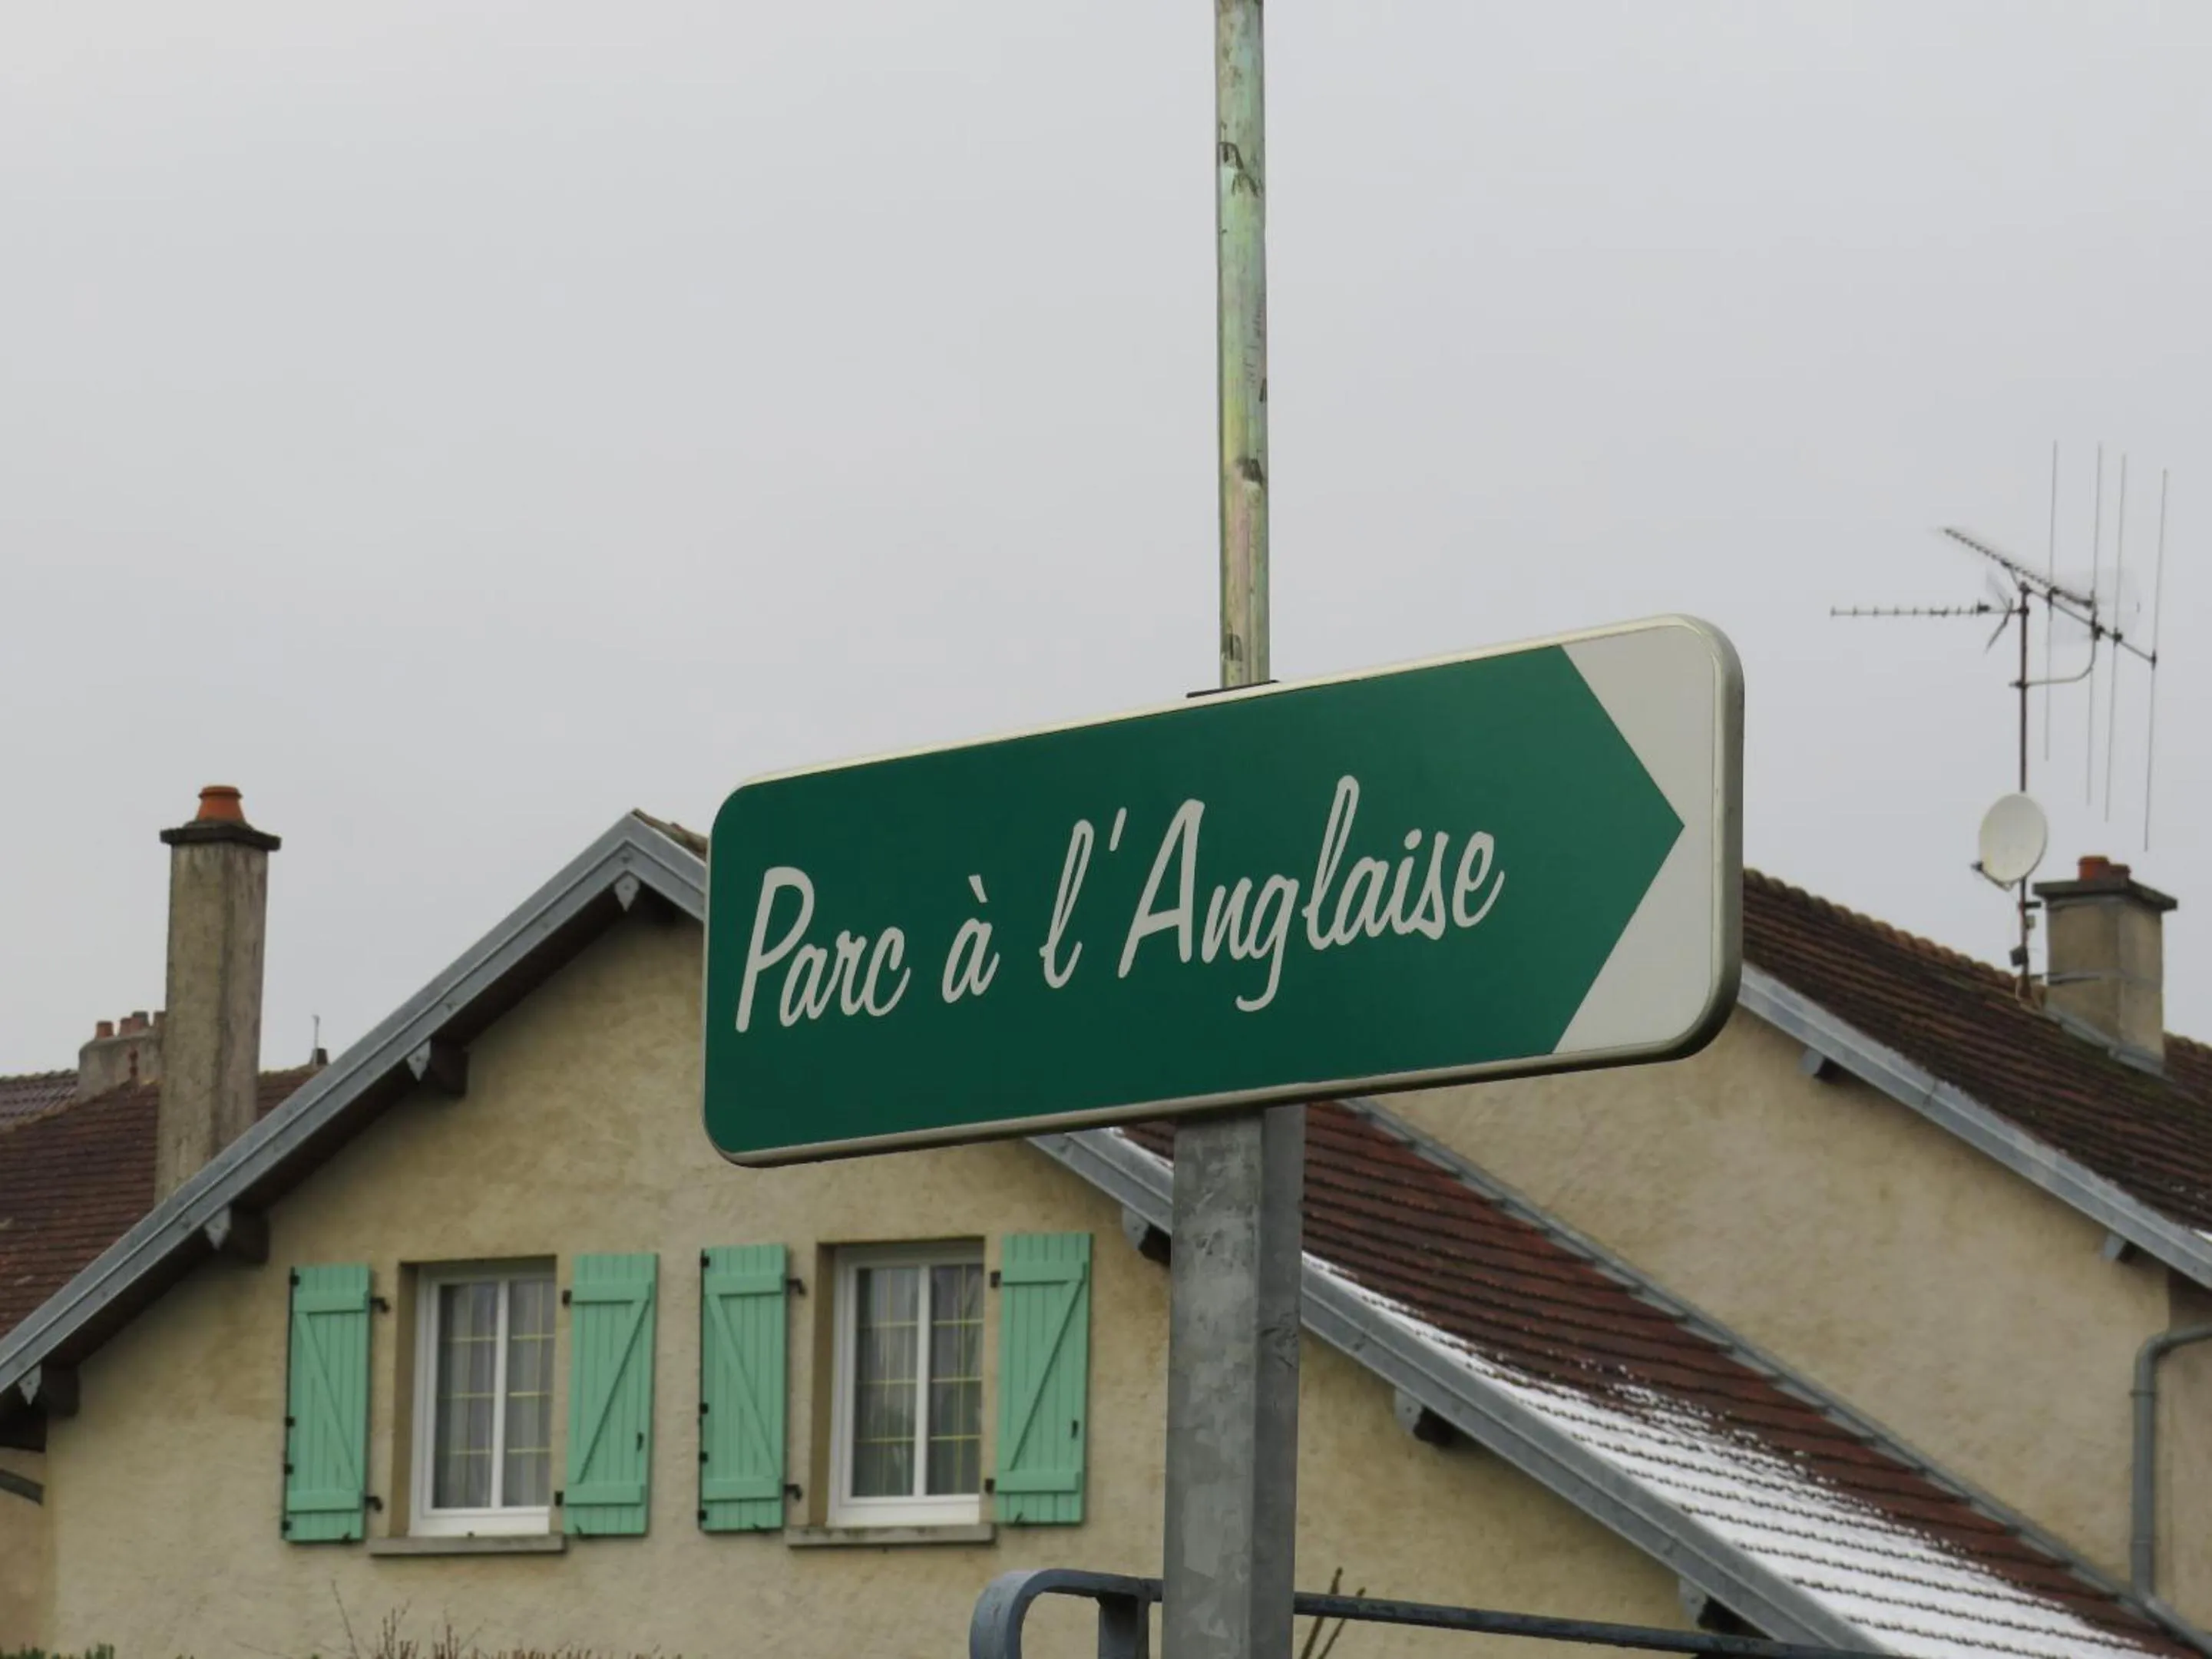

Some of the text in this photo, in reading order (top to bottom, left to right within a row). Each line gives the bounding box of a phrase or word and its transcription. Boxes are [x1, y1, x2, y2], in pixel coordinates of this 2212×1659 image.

[735, 775, 1506, 1033] Parc à l'Anglaise
